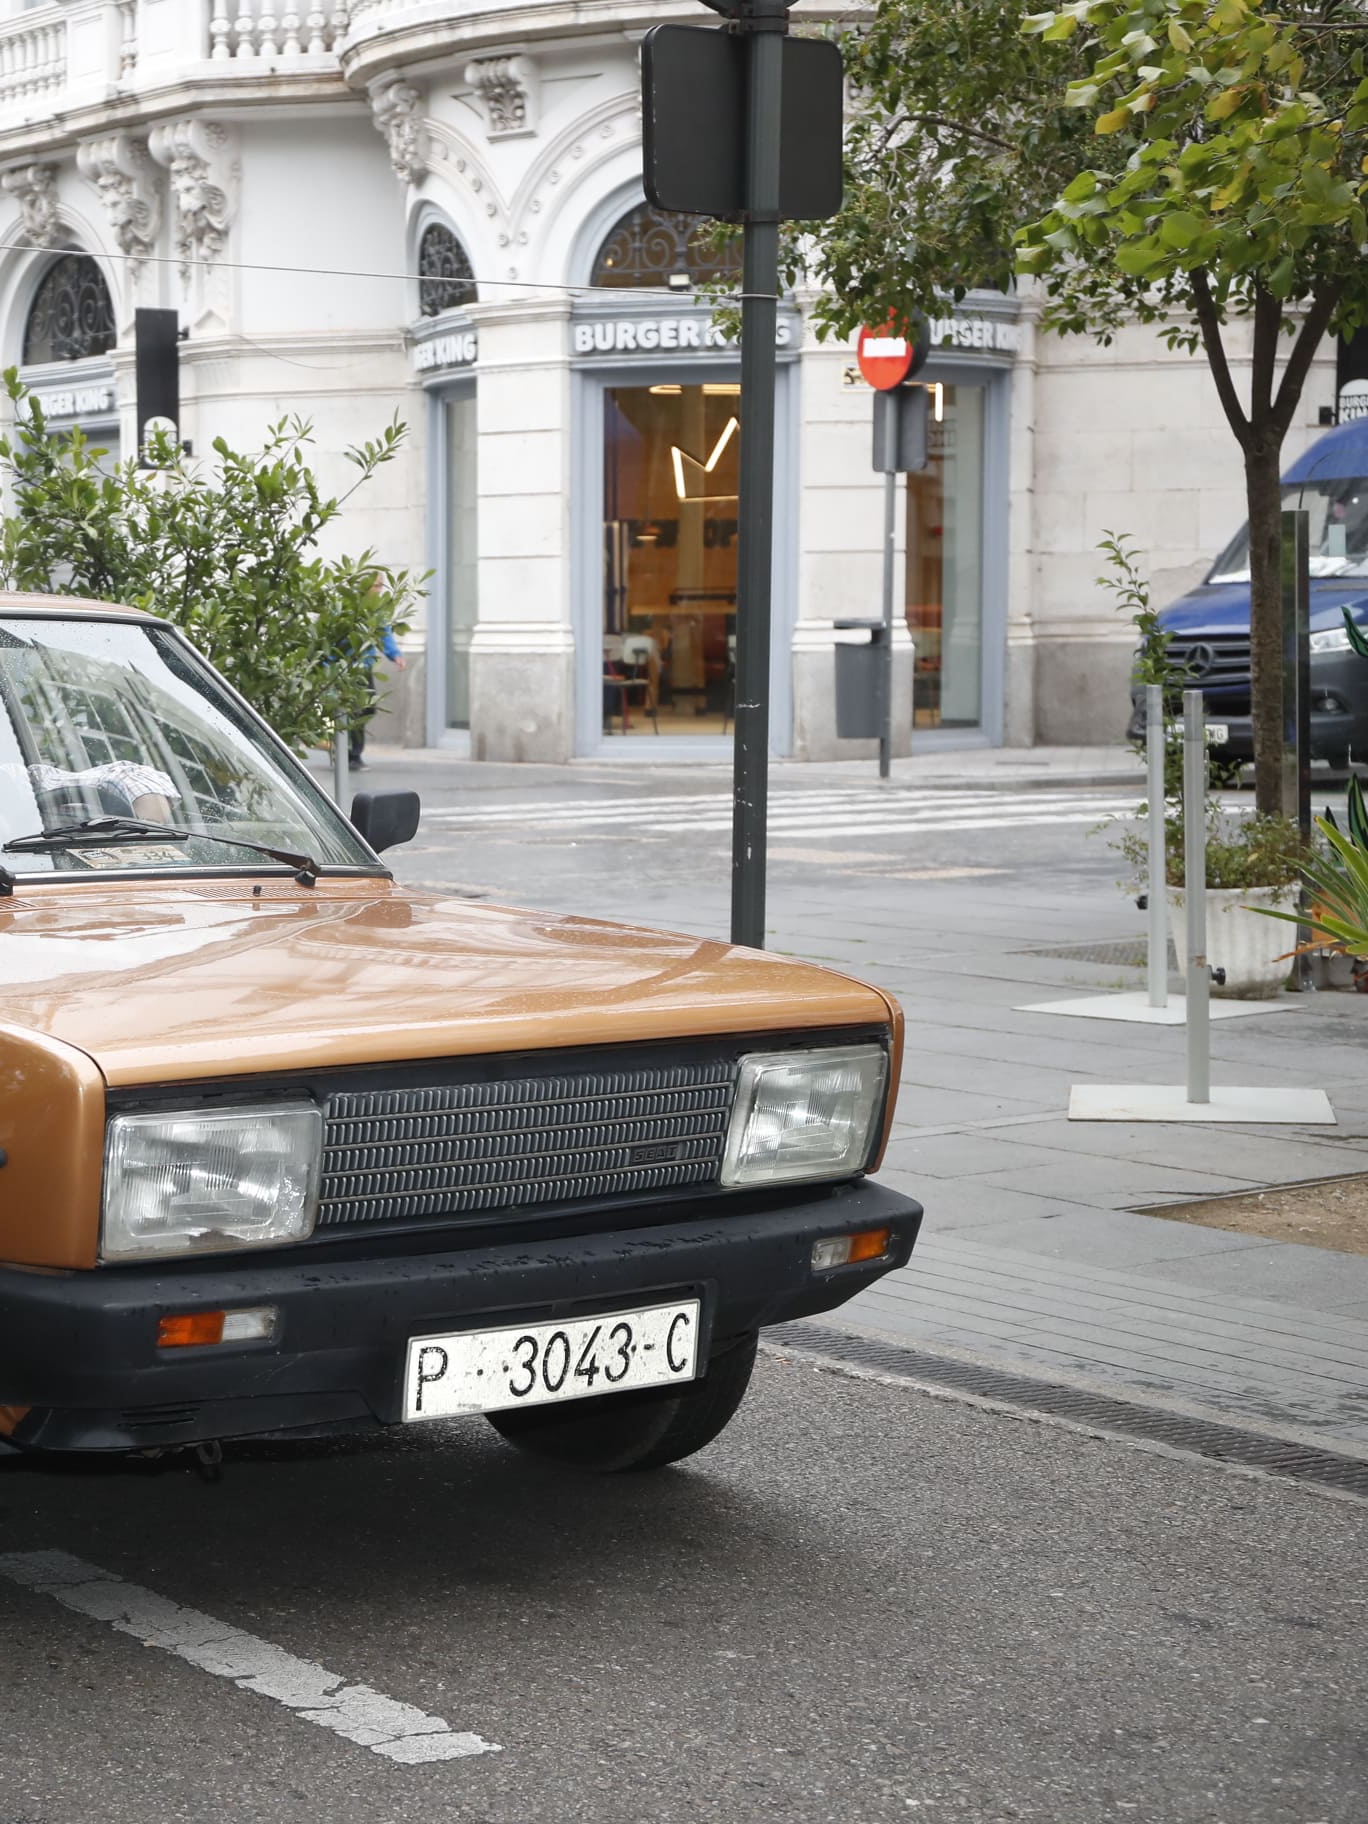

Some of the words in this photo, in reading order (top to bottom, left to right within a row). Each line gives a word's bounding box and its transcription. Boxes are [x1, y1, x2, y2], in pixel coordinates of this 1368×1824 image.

[575, 319, 700, 352] BURGER
[929, 317, 994, 349] URGER
[435, 334, 476, 365] KING
[75, 386, 109, 412] KING
[634, 1144, 679, 1162] SEAT
